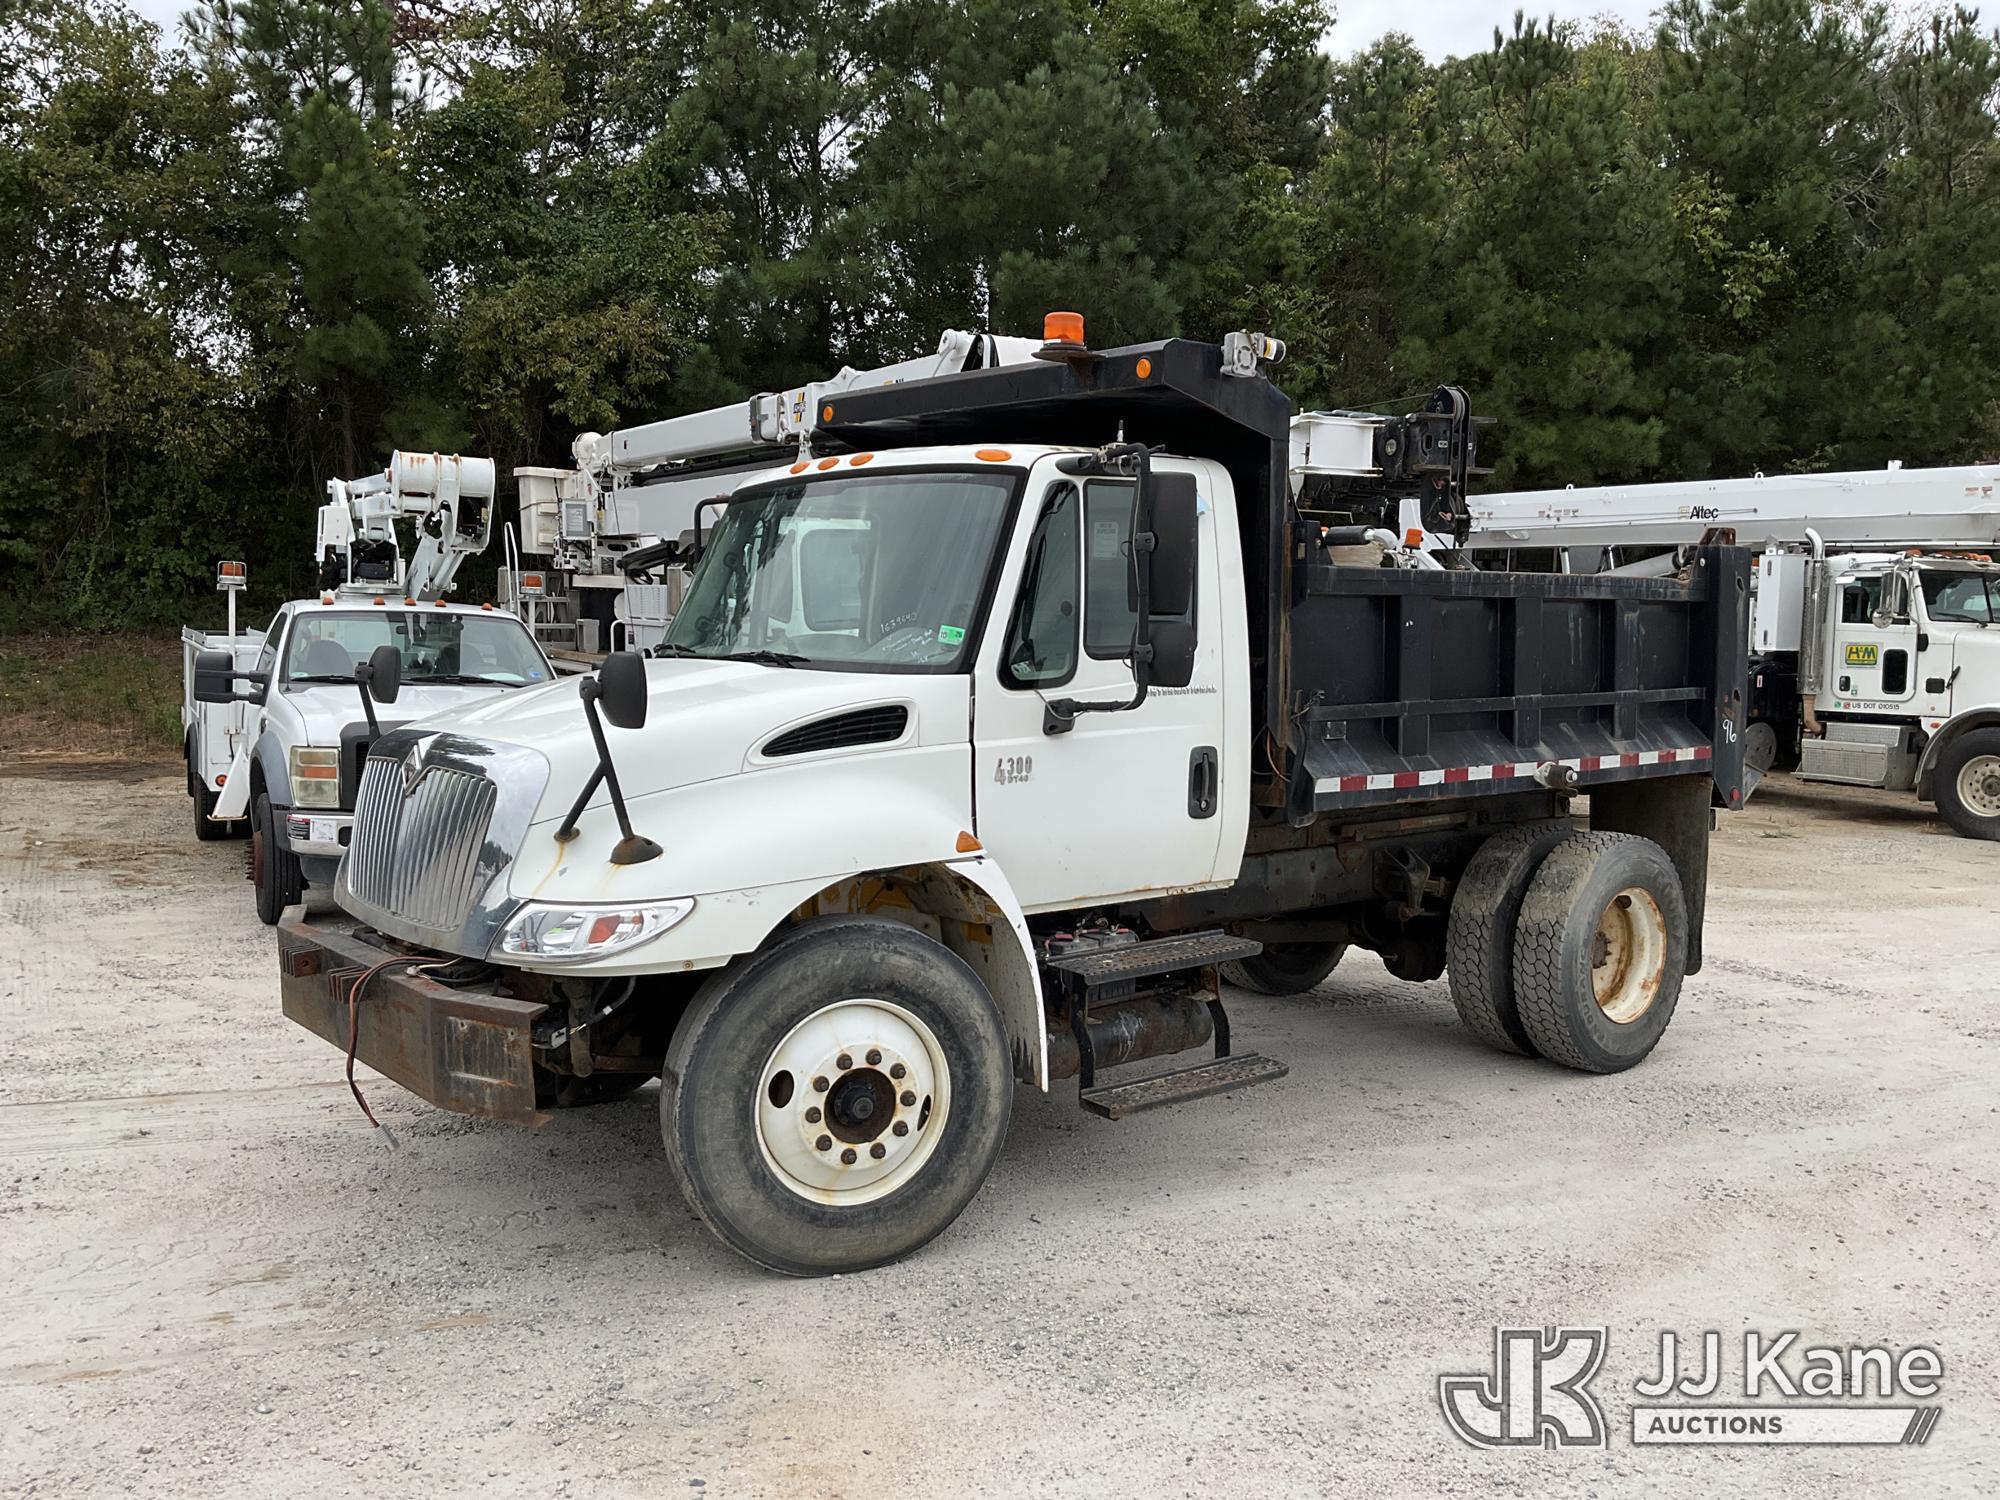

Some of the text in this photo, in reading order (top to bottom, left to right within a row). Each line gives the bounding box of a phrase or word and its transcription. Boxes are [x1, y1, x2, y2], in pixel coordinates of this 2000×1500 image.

[1690, 505, 1719, 520] Altec
[1722, 719, 1737, 744] 96
[994, 755, 1033, 785] 4300
